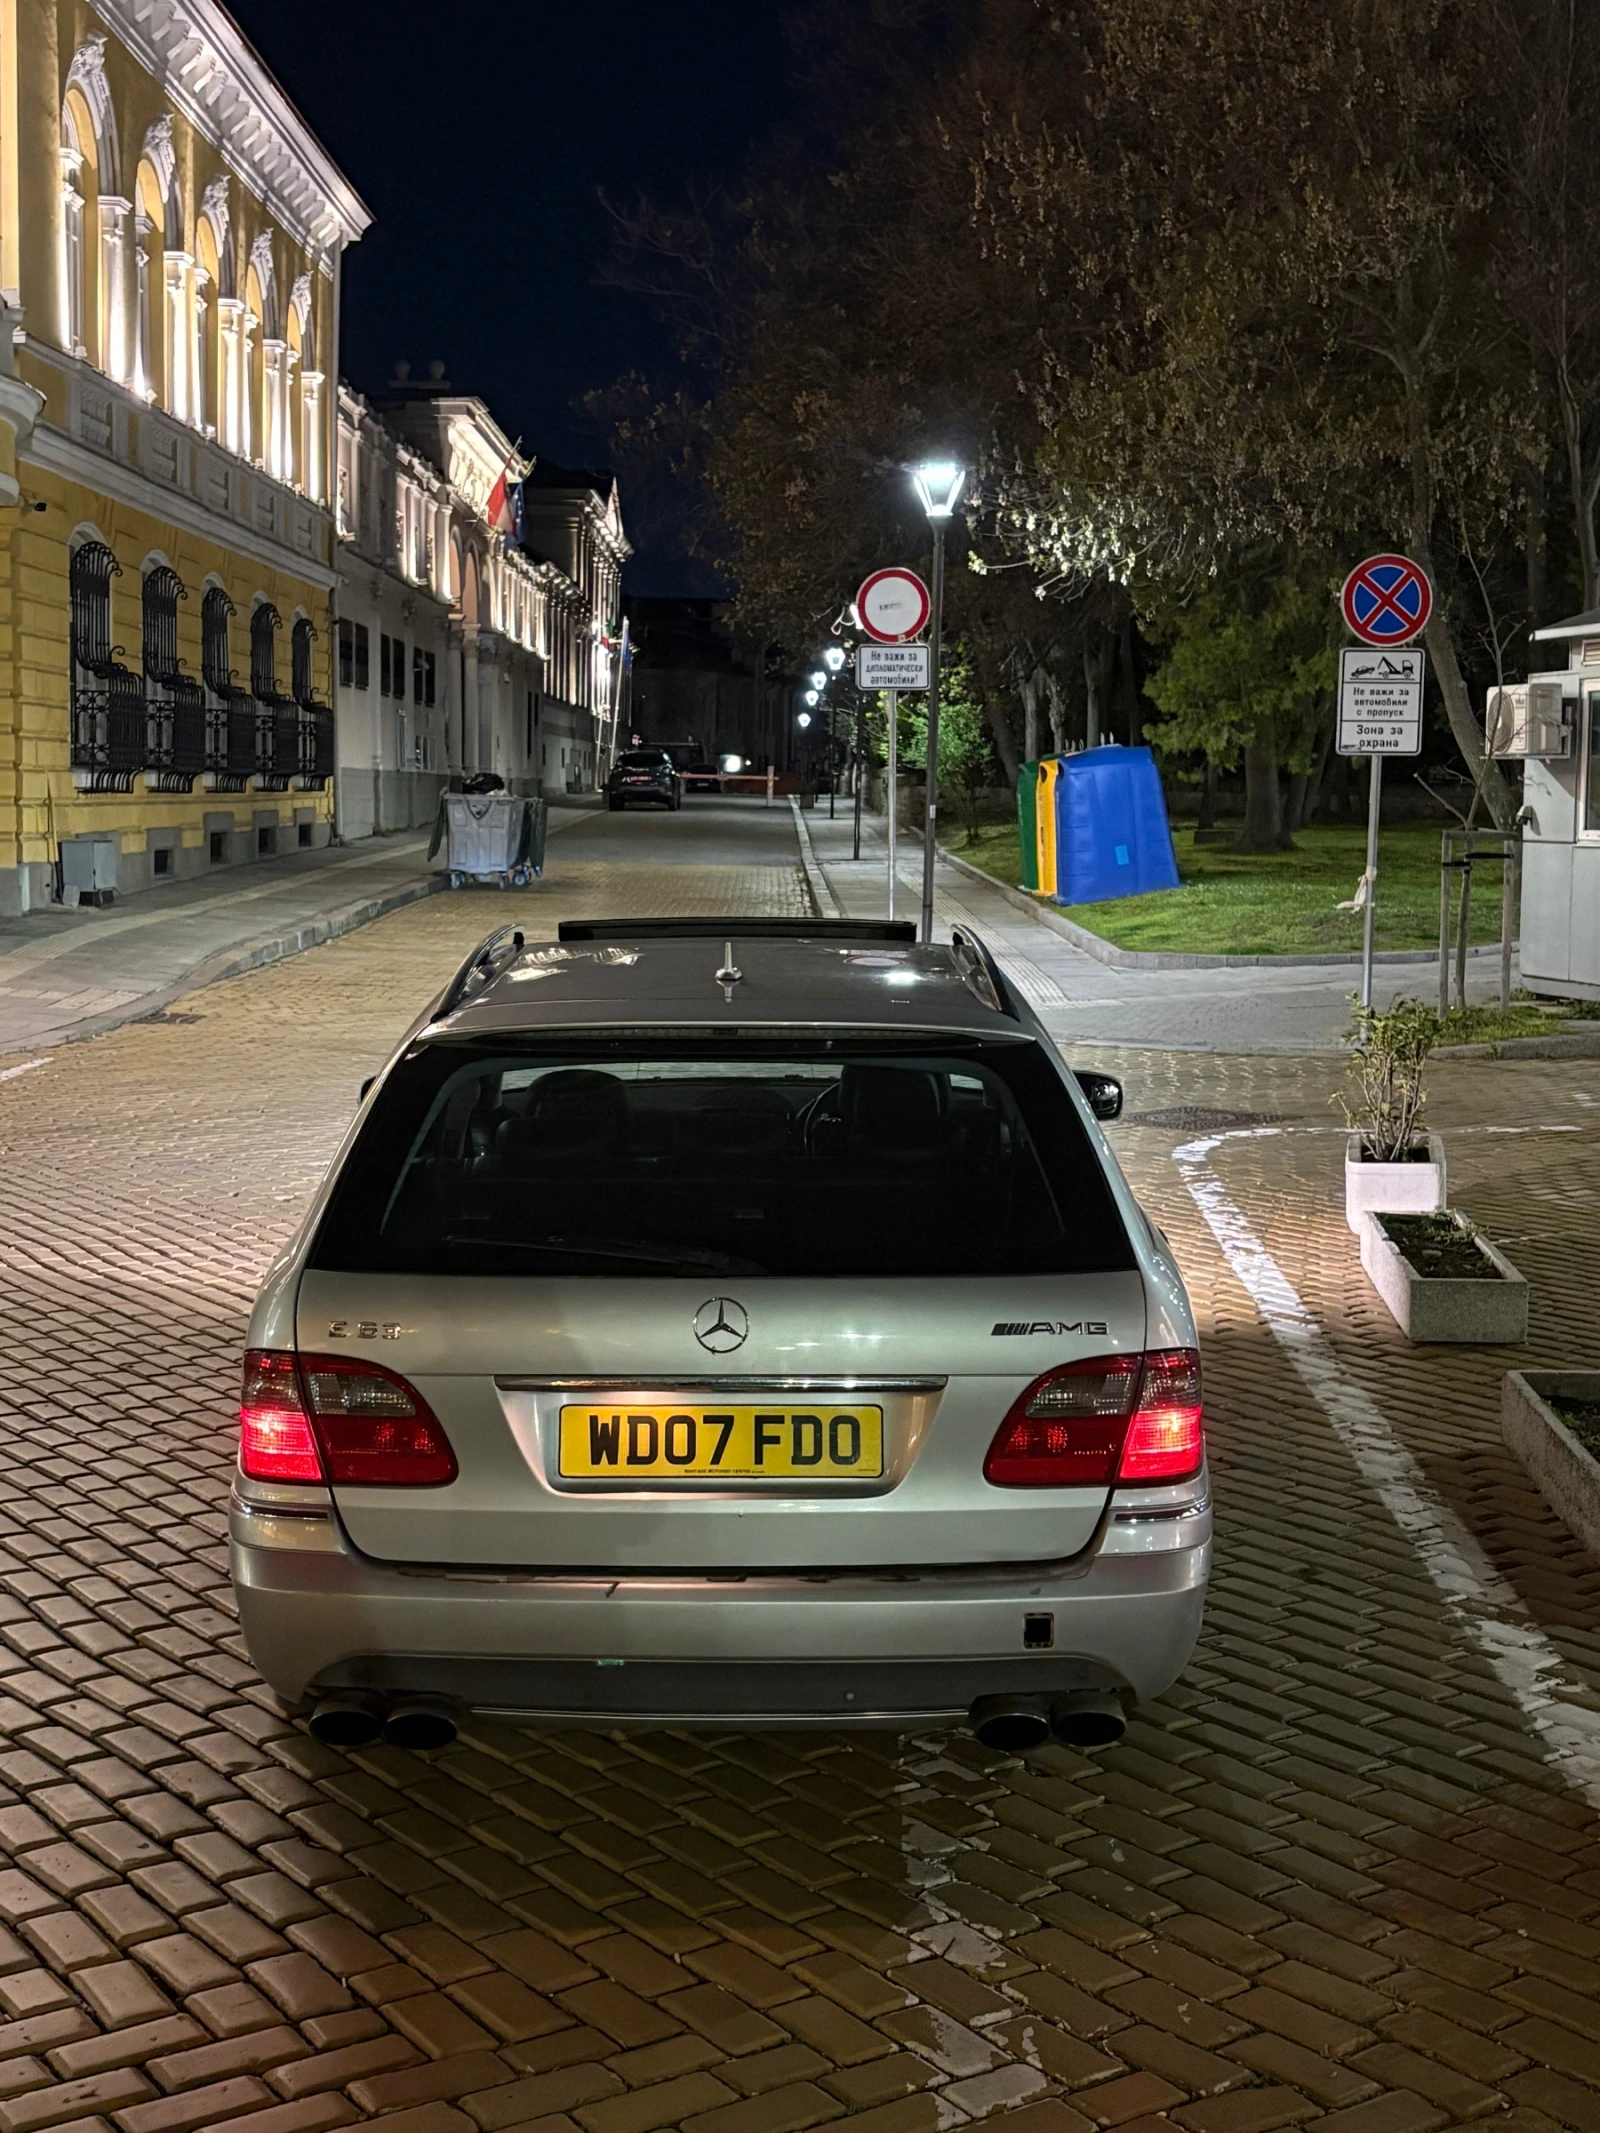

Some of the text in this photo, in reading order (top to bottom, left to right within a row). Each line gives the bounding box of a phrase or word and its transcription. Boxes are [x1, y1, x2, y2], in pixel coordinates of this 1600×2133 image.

[871, 650, 917, 661] Не важи за
[1353, 687, 1365, 696] Не
[1354, 698, 1408, 706] автомобили
[1367, 709, 1404, 717] пропуск
[1356, 724, 1403, 735] Зона за
[1359, 740, 1399, 749] охрана
[1028, 1321, 1109, 1336] AMG
[589, 1414, 861, 1466] WD07 FDO
